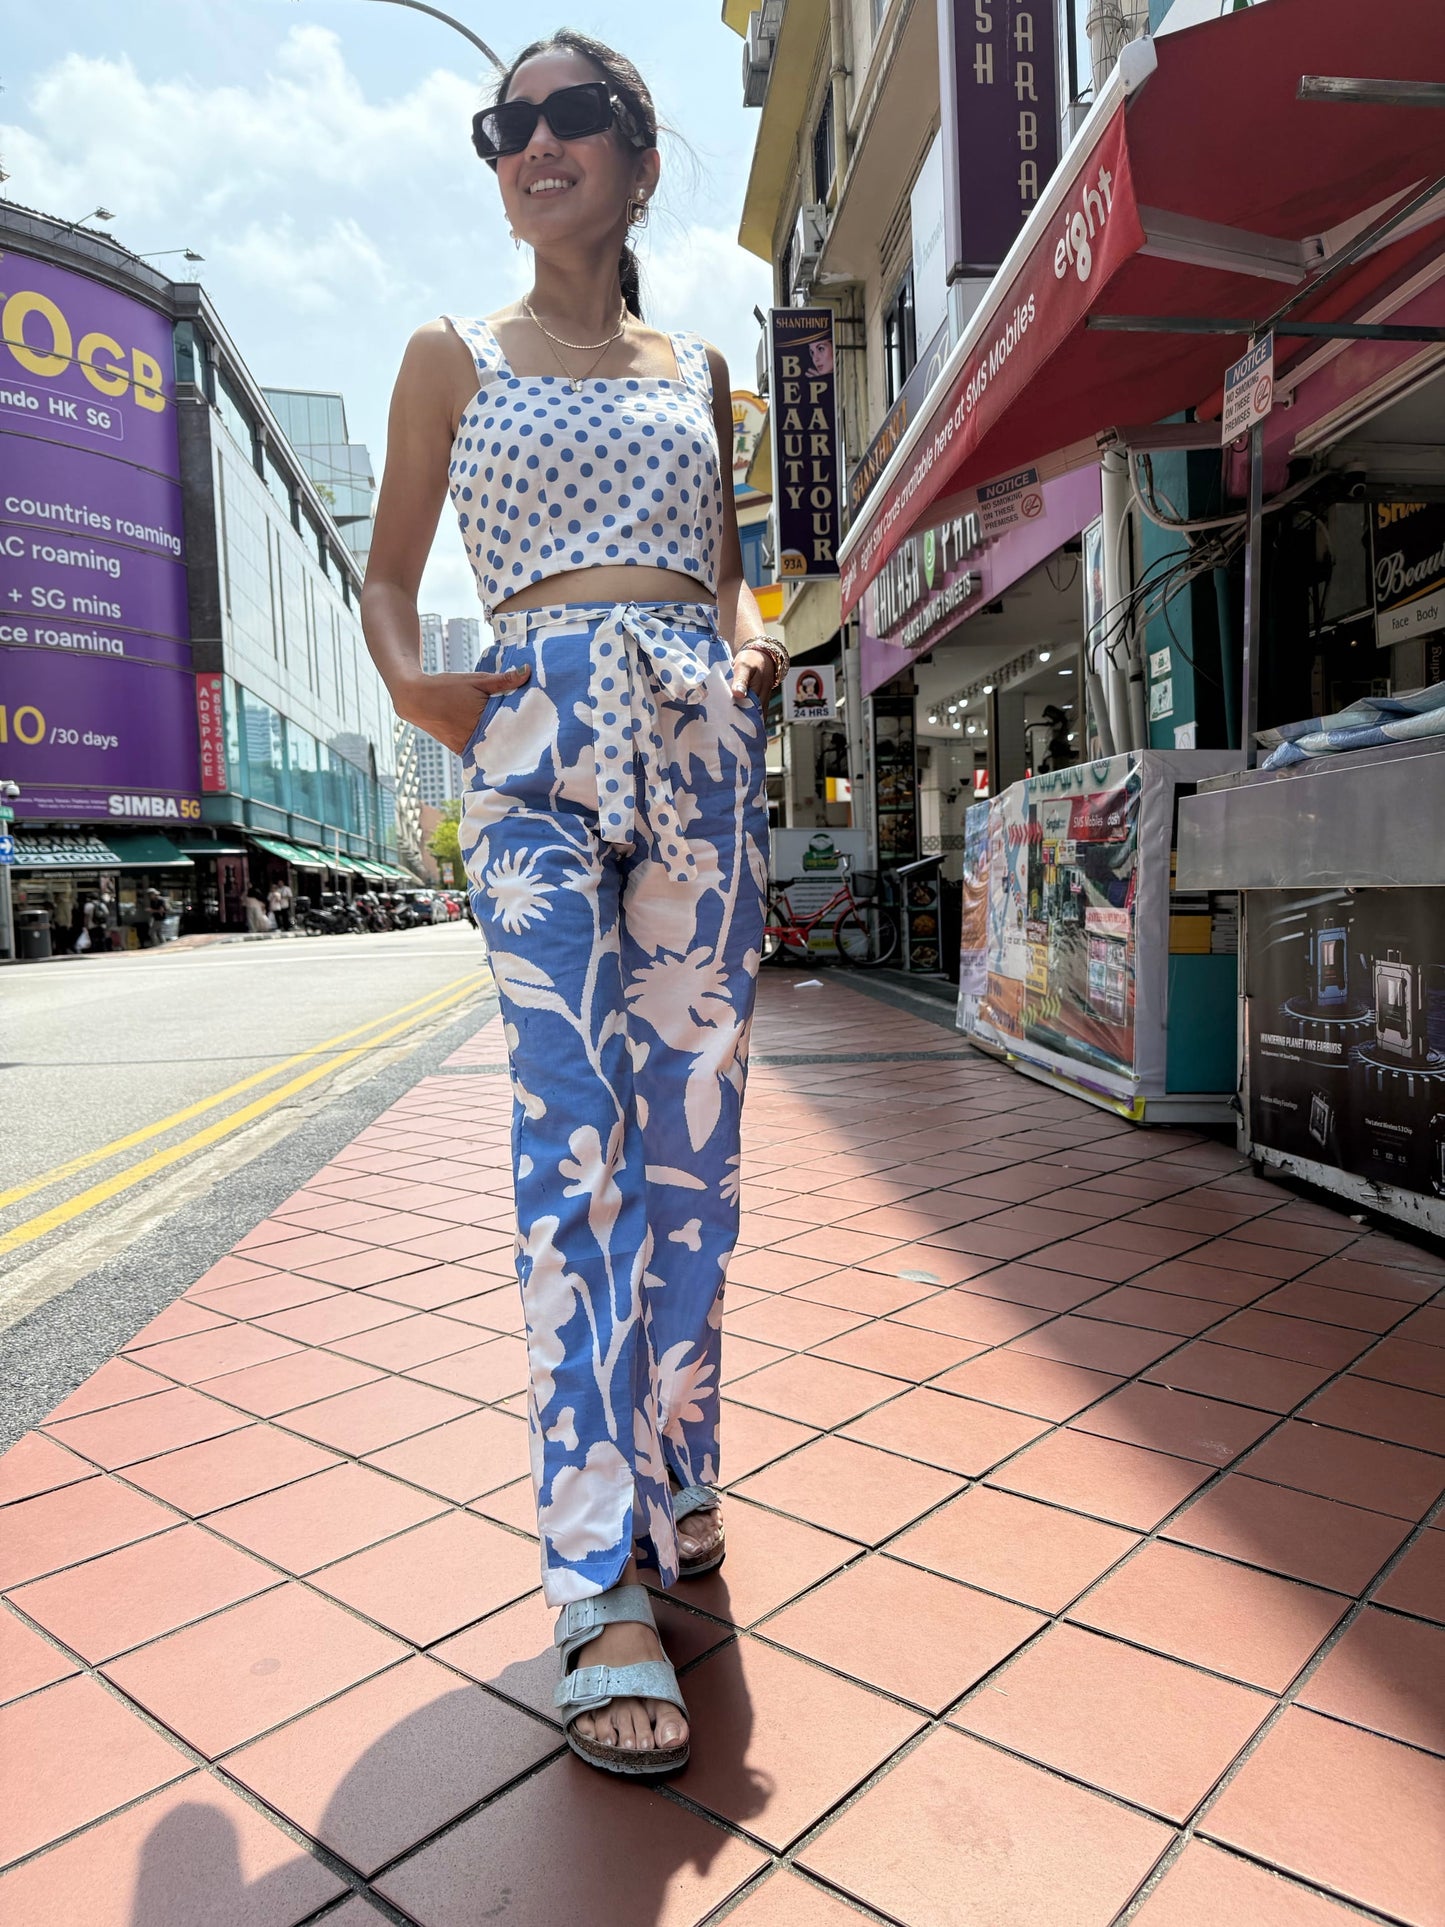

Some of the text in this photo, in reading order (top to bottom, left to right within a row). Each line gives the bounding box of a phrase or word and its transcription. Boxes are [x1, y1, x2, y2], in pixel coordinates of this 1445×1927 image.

[1014, 0, 1038, 216] ARBA
[1054, 165, 1112, 282] eight
[1232, 342, 1267, 384] NOTICE
[900, 446, 933, 508] available
[934, 417, 953, 460] here
[954, 395, 965, 431] at
[966, 359, 987, 413] SMS
[989, 292, 1035, 382] Mobiles
[1226, 371, 1260, 404] NO SMOKING
[48, 397, 78, 421] HK
[86, 408, 112, 430] SG
[1226, 393, 1251, 420] ON THESE
[781, 355, 804, 510] BEAUTY
[1225, 407, 1251, 434] PREMISES
[808, 381, 834, 562] PARLOUR
[986, 473, 1030, 499] NOTICE
[981, 491, 1023, 512] NO SMOKING
[983, 504, 1016, 521] ON THESE
[5, 496, 182, 556] countries roaming
[985, 513, 1019, 530] PREMISES
[31, 543, 121, 579] roaming
[784, 557, 803, 571] 93A
[31, 586, 66, 610] SG
[72, 595, 122, 619] mins
[944, 571, 972, 613] SWEETS
[1392, 605, 1439, 630] Face Body
[35, 631, 124, 656] roaming
[794, 708, 830, 718] 24 HRS
[50, 727, 79, 745] /30
[83, 731, 119, 750] days
[200, 687, 213, 777] ADSPACE
[109, 794, 201, 820] SIMBA 5G
[1085, 813, 1103, 827] Mobiles
[1286, 1036, 1304, 1049] PLANET
